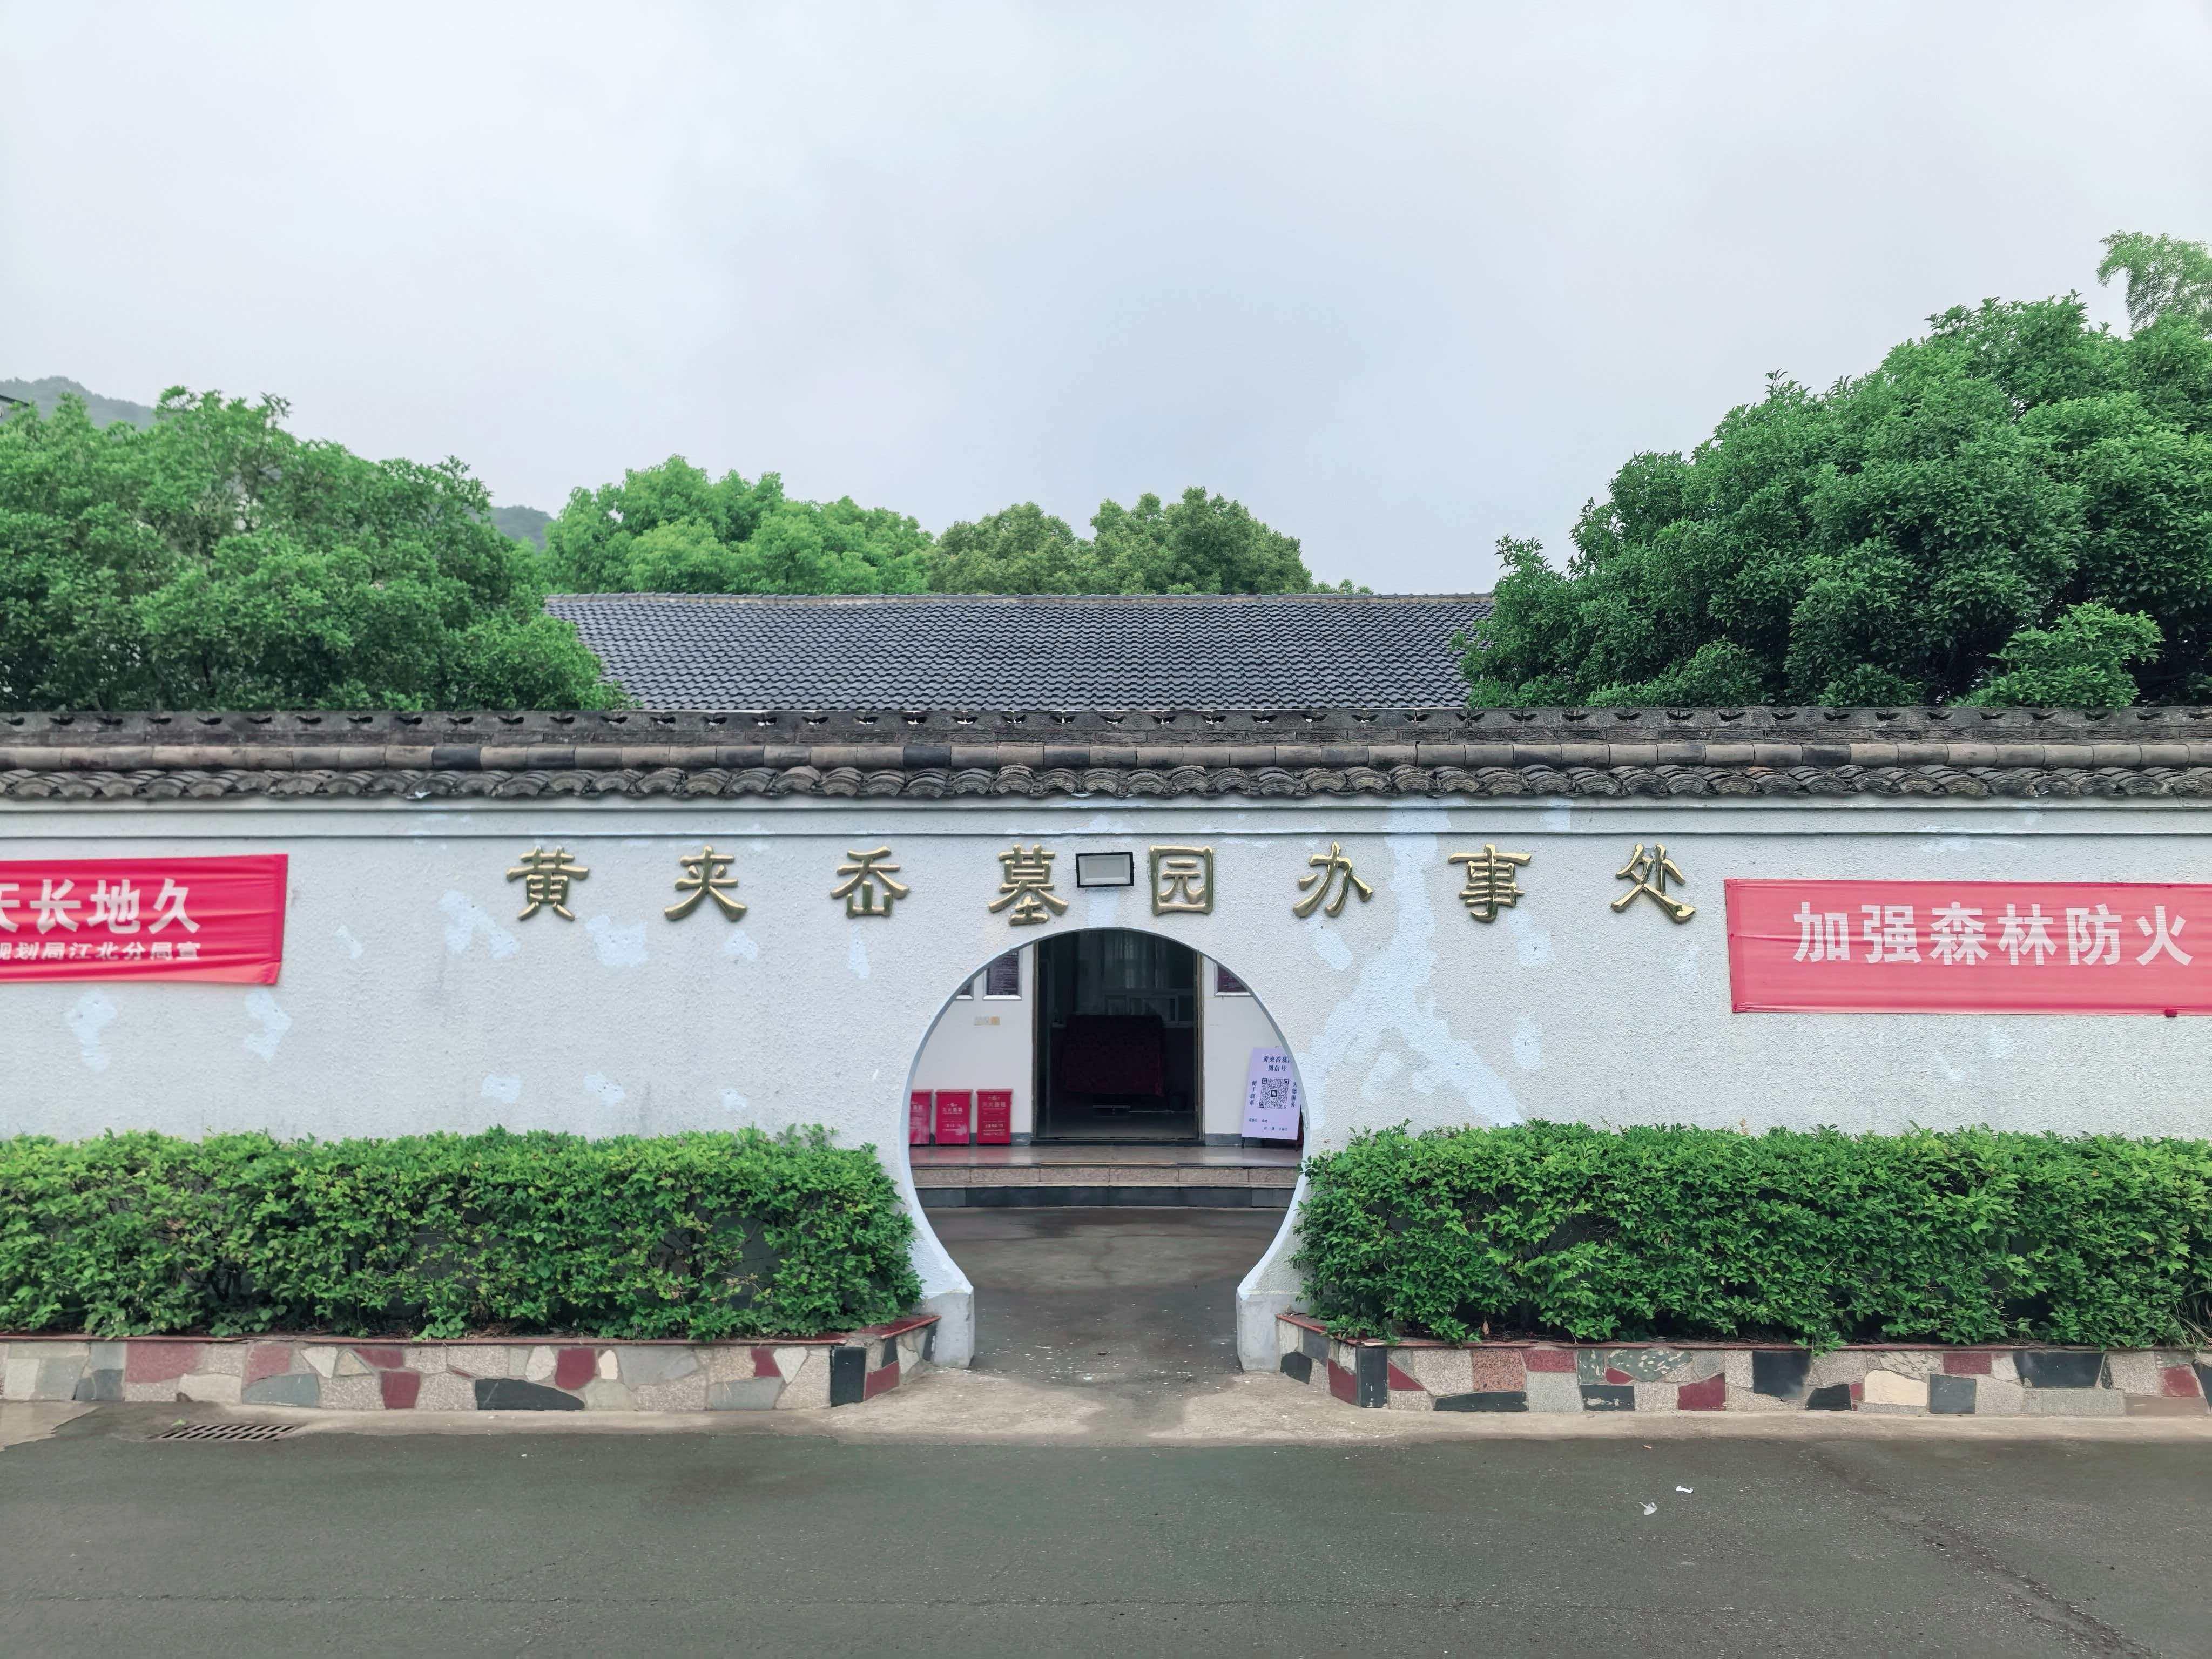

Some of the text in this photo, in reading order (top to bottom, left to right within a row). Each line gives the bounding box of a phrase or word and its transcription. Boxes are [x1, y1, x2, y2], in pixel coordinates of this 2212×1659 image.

[507, 841, 1696, 926] 黄夹岙墓园办事处
[1793, 902, 2193, 966] 加强森林防火
